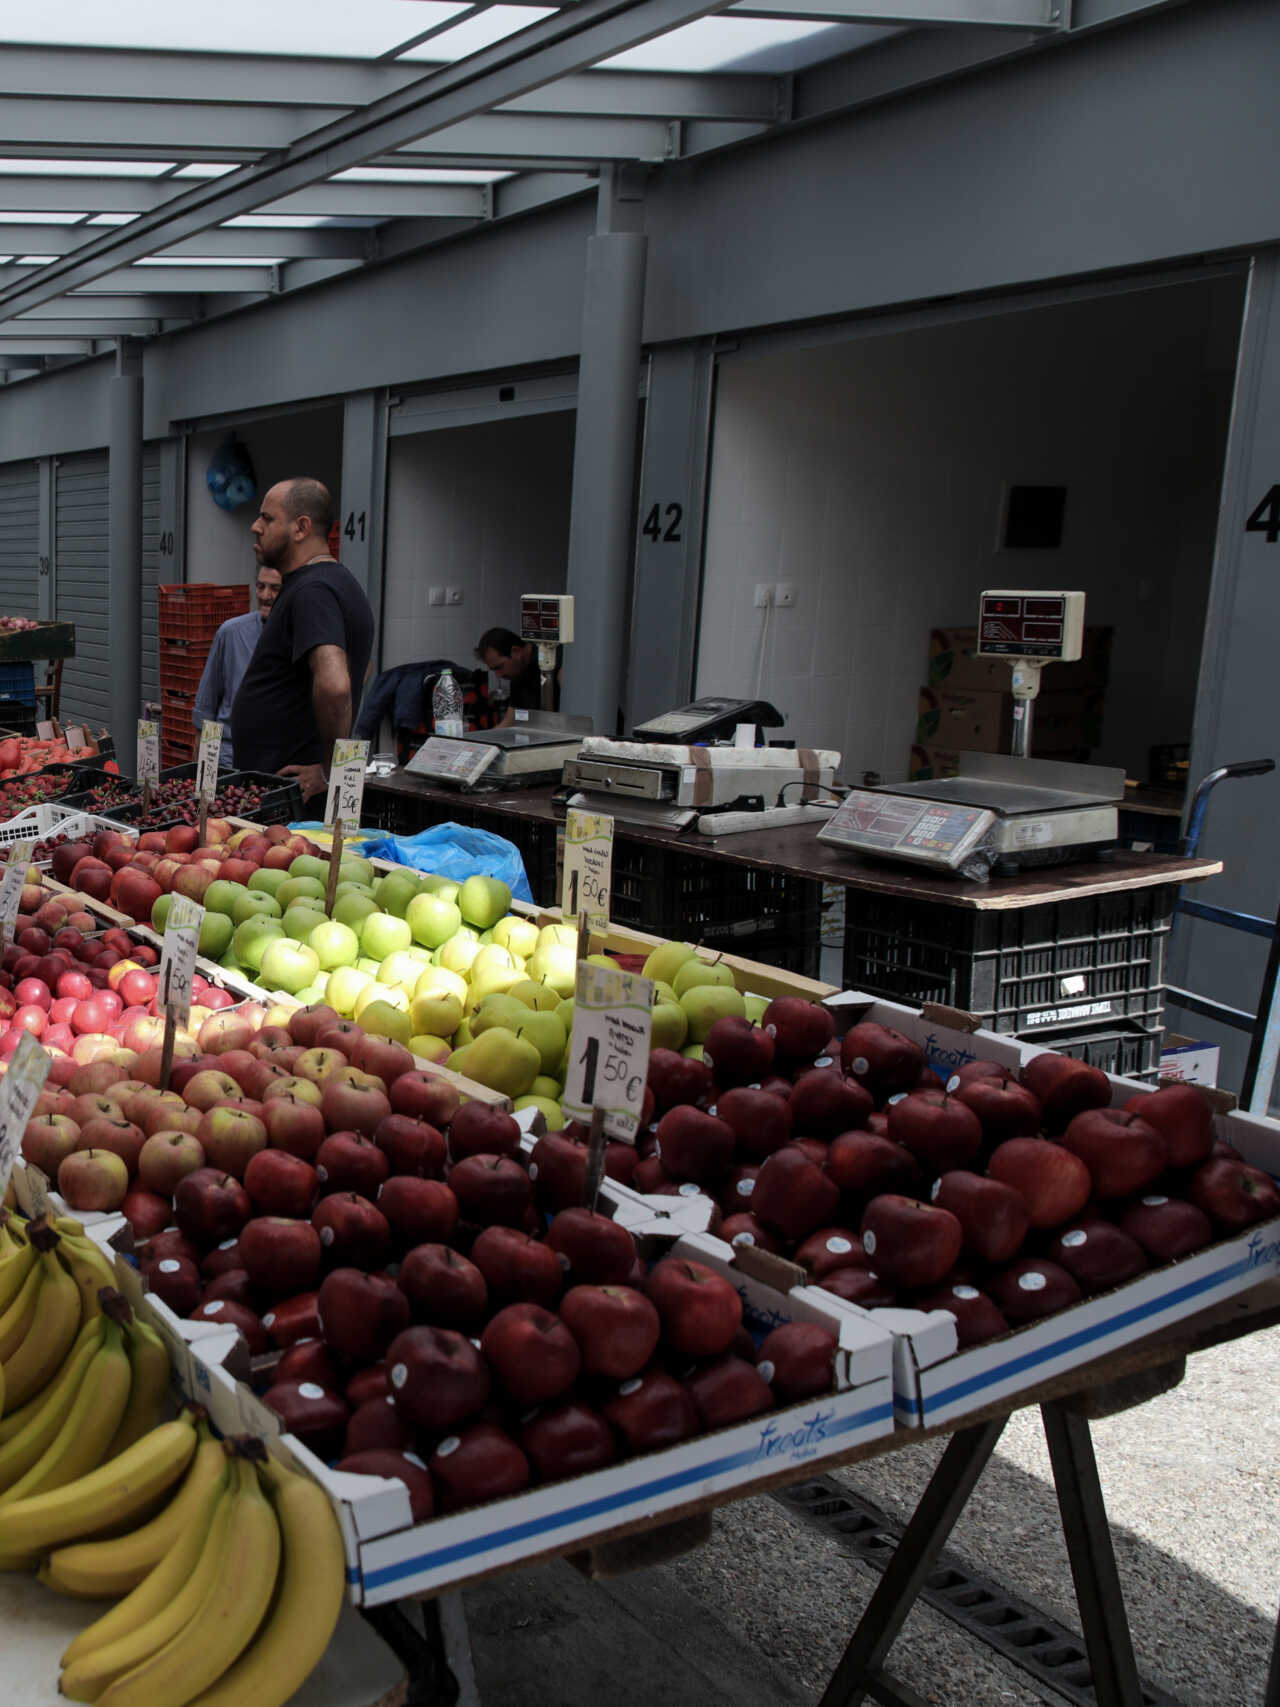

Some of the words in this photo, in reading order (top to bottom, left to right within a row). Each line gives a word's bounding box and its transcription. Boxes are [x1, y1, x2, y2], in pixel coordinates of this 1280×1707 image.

[344, 511, 366, 541] 41
[643, 502, 682, 543] 42
[160, 532, 173, 555] 40
[39, 556, 49, 576] 39
[331, 785, 340, 824] 1
[569, 870, 578, 915] 1
[579, 1036, 599, 1105] 1
[760, 1410, 834, 1457] froots
